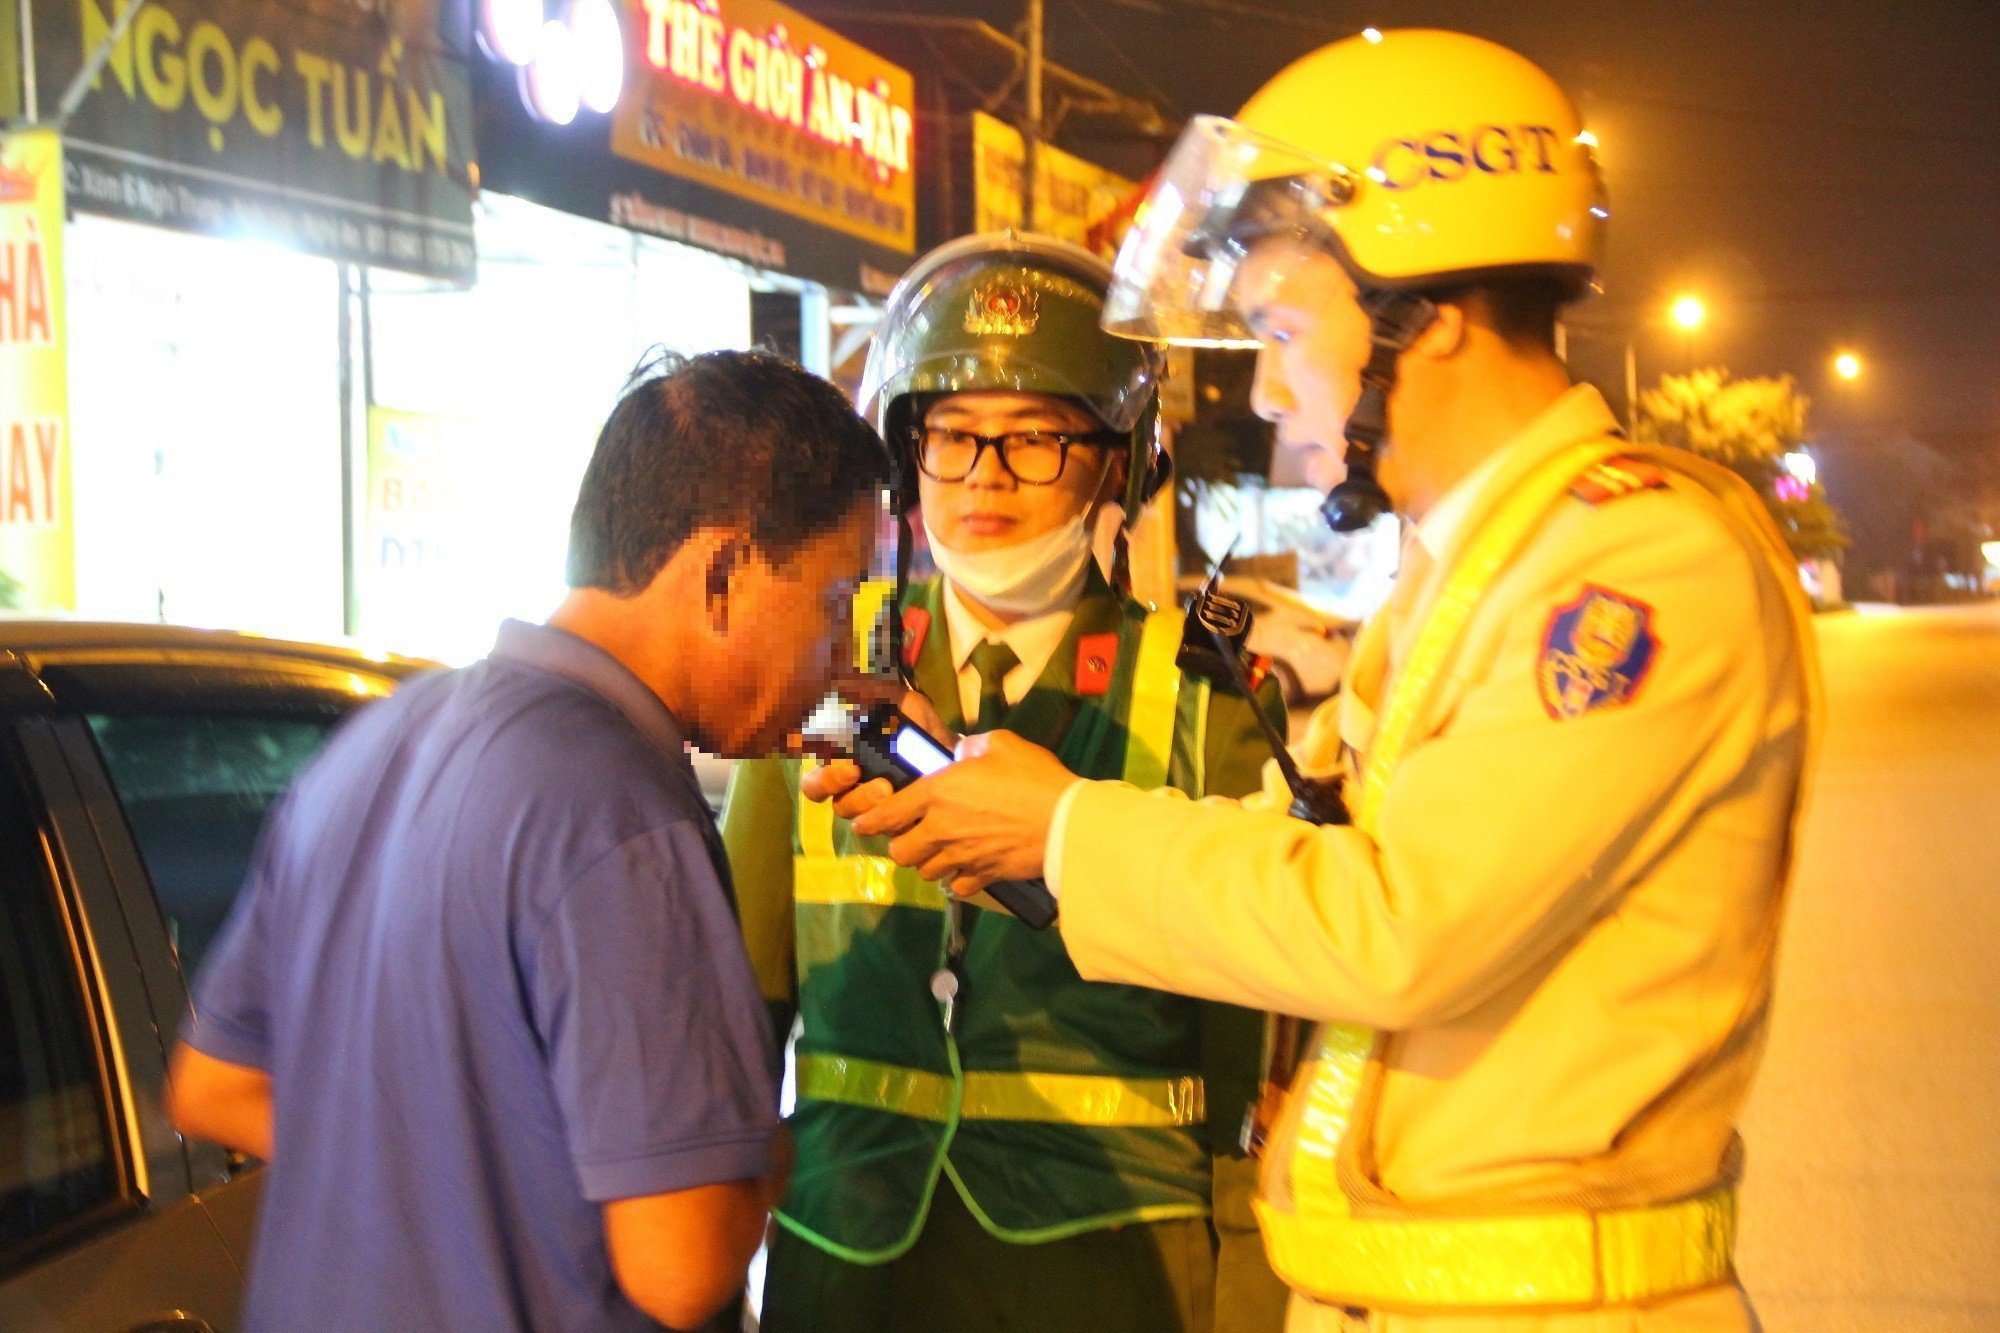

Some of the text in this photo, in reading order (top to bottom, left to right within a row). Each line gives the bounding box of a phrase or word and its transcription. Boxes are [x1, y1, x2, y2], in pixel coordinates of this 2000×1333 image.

[79, 0, 448, 174] NGỌC TUẤN
[1371, 122, 1560, 192] CSGT
[0, 422, 58, 524] AY
